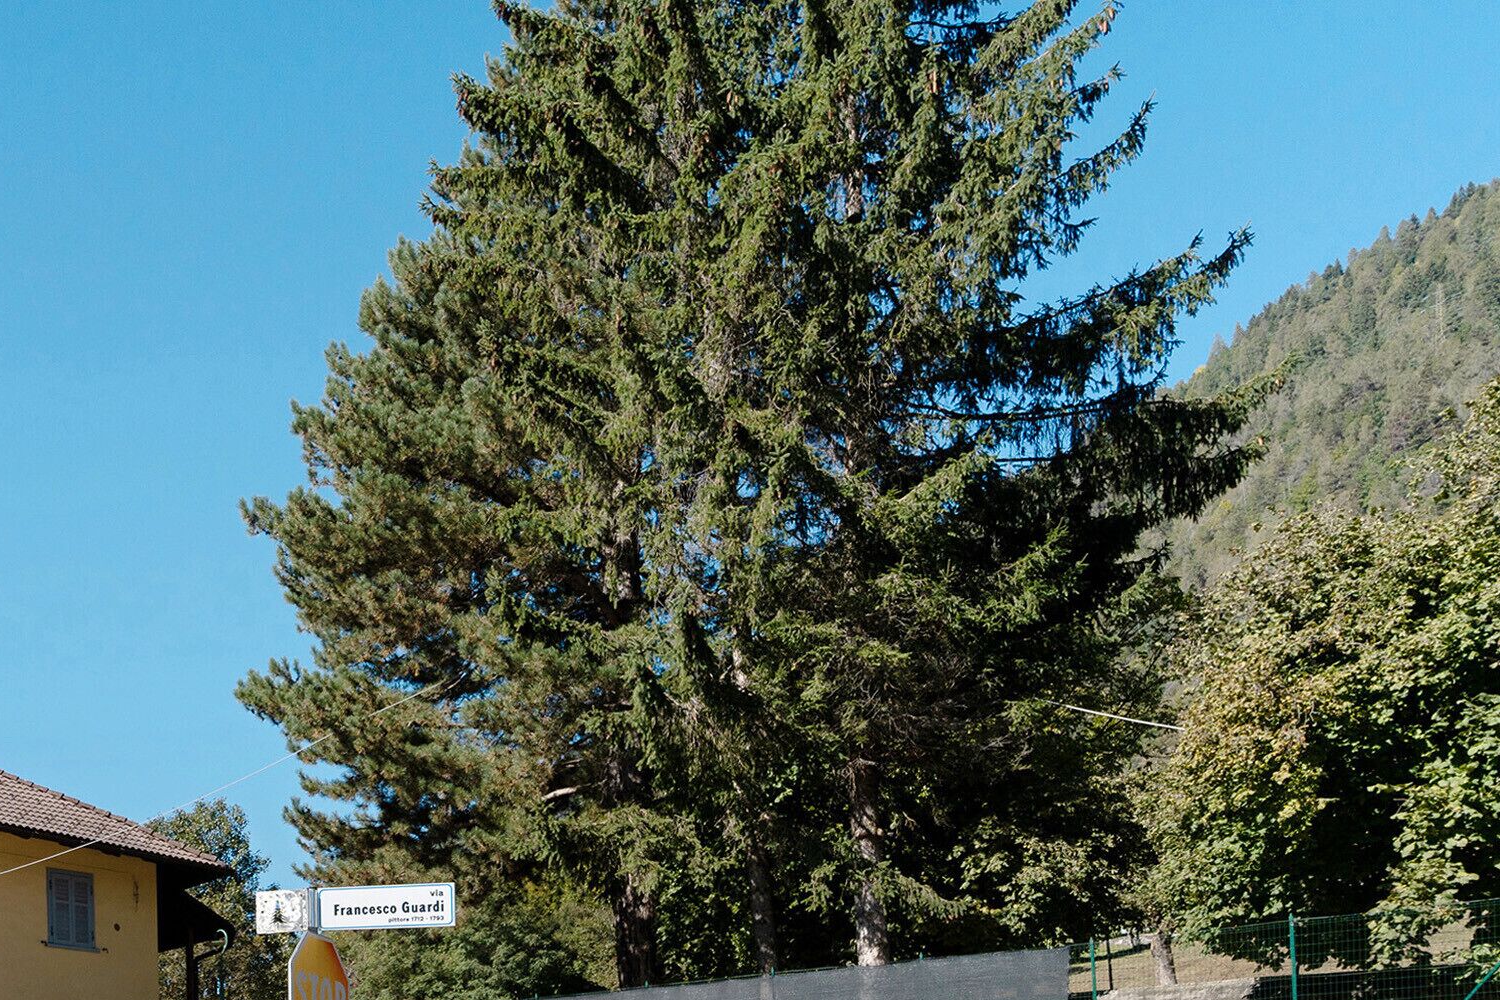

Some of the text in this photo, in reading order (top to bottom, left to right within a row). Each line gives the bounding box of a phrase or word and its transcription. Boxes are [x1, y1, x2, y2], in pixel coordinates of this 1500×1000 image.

[430, 889, 444, 897] via
[333, 900, 445, 916] Francesco Guardi
